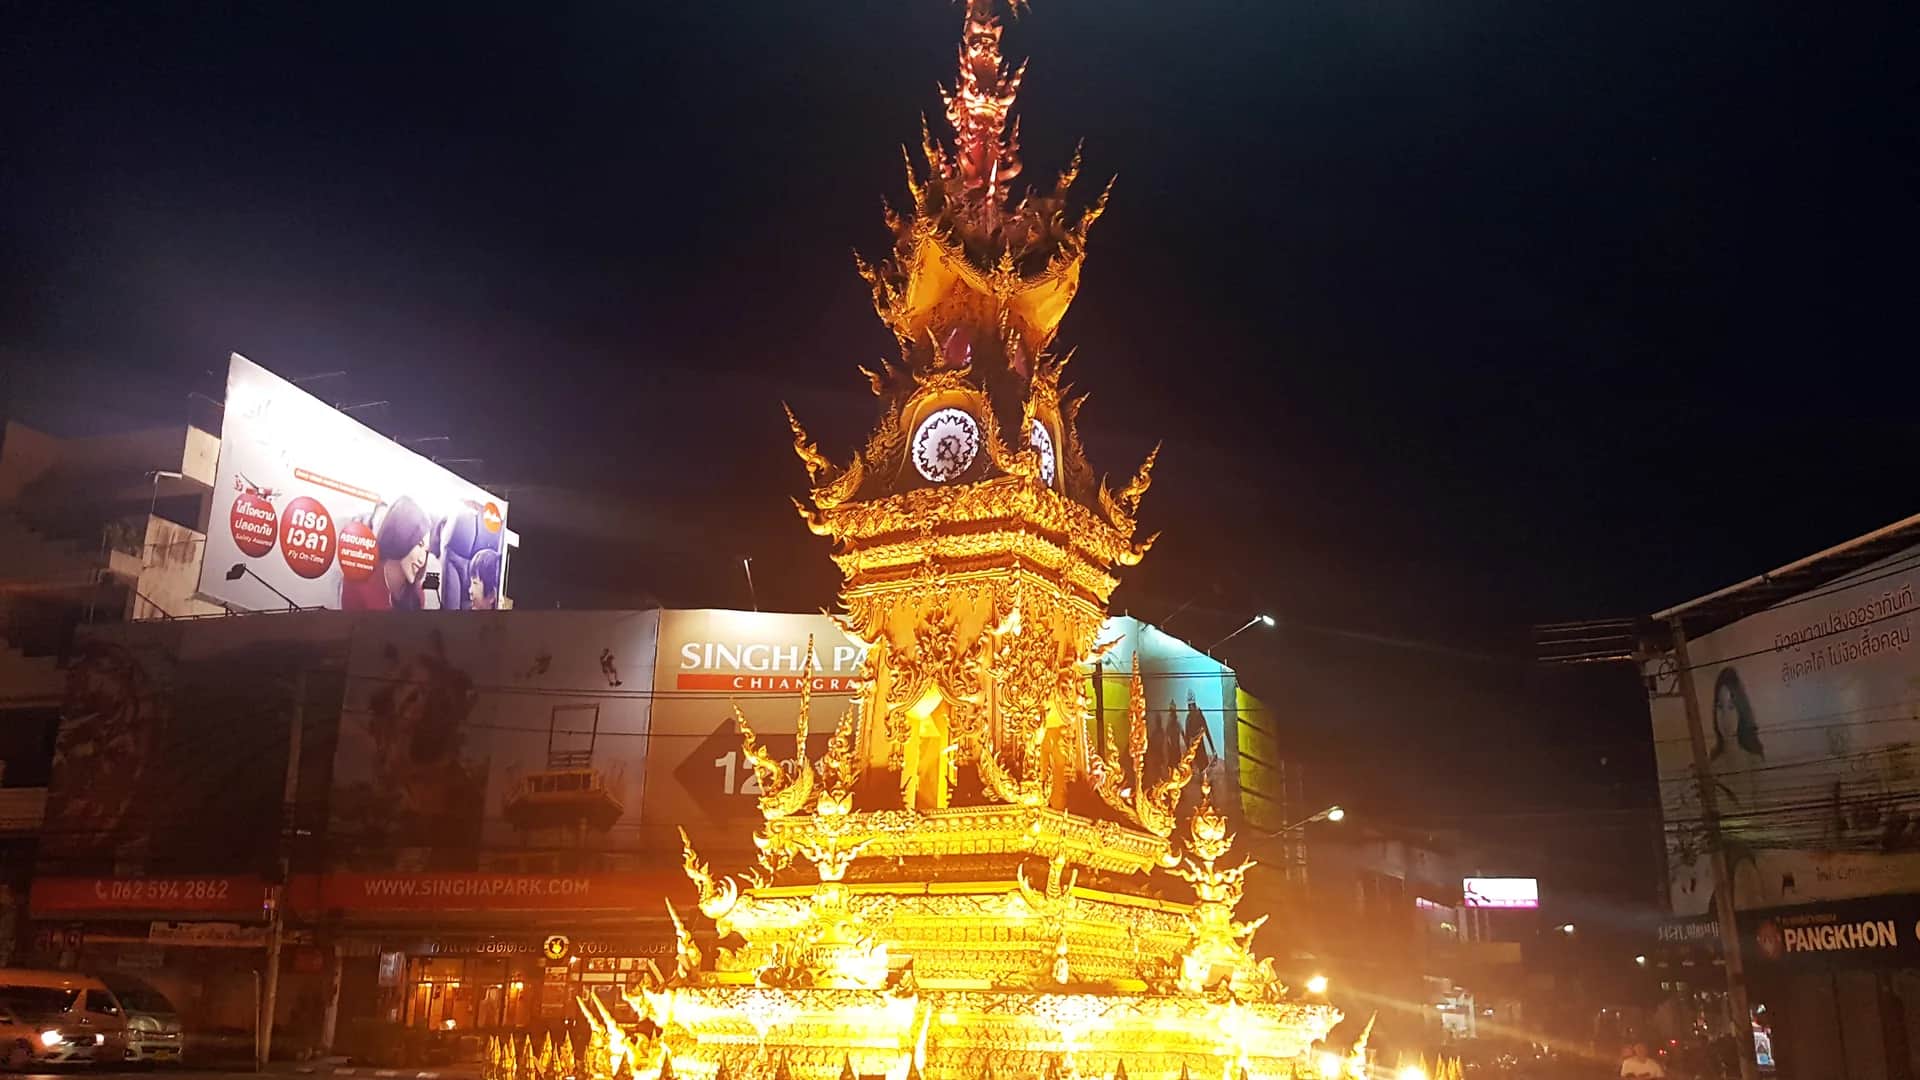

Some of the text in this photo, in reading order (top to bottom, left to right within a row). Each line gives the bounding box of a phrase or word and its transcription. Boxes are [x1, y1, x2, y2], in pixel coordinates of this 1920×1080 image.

[235, 517, 272, 536] ปลอดภัย
[291, 509, 328, 531] ตรง
[287, 527, 328, 552] เวลา
[680, 643, 823, 671] SINGHA
[733, 676, 860, 690] CHIANGRA
[111, 881, 229, 899] 062 594 2862
[365, 880, 590, 896] WWW.SINGHAPARK.COM
[1784, 920, 1898, 952] PANGKHON
